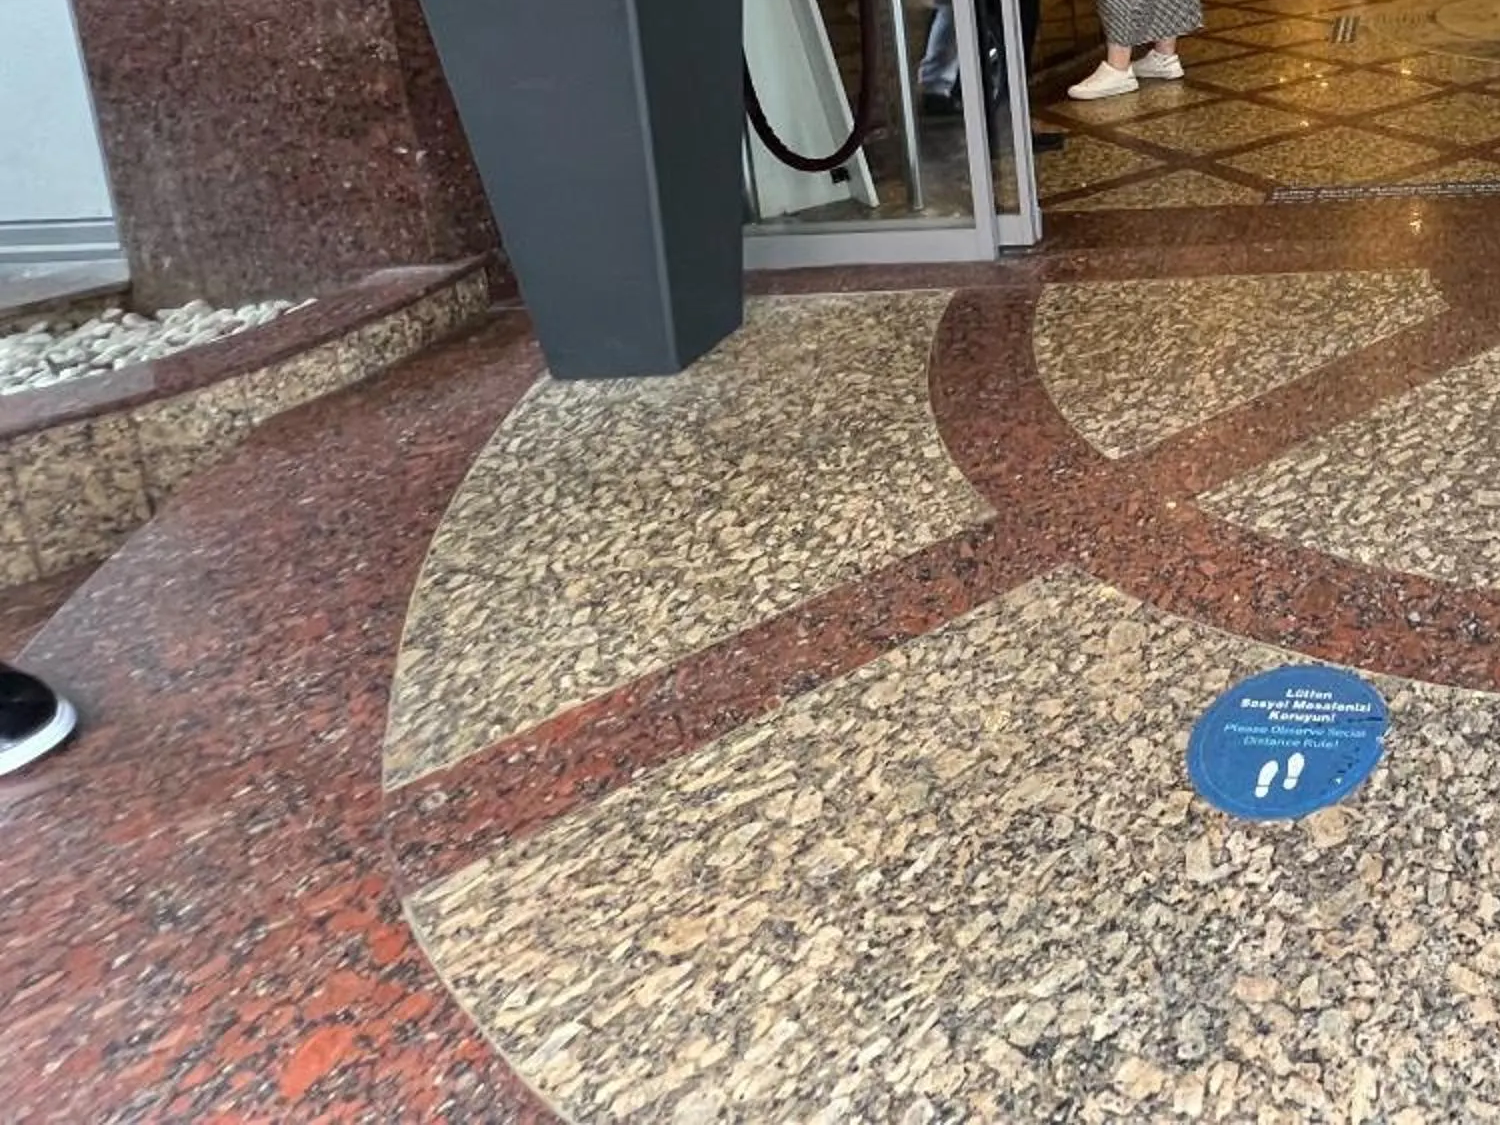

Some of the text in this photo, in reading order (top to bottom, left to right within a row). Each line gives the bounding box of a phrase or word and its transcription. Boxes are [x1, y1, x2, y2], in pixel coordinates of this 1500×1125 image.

[1286, 688, 1333, 700] Lütfen
[1240, 698, 1371, 713] Sosyal Mesafenizi
[1268, 710, 1336, 724] Koruyun!
